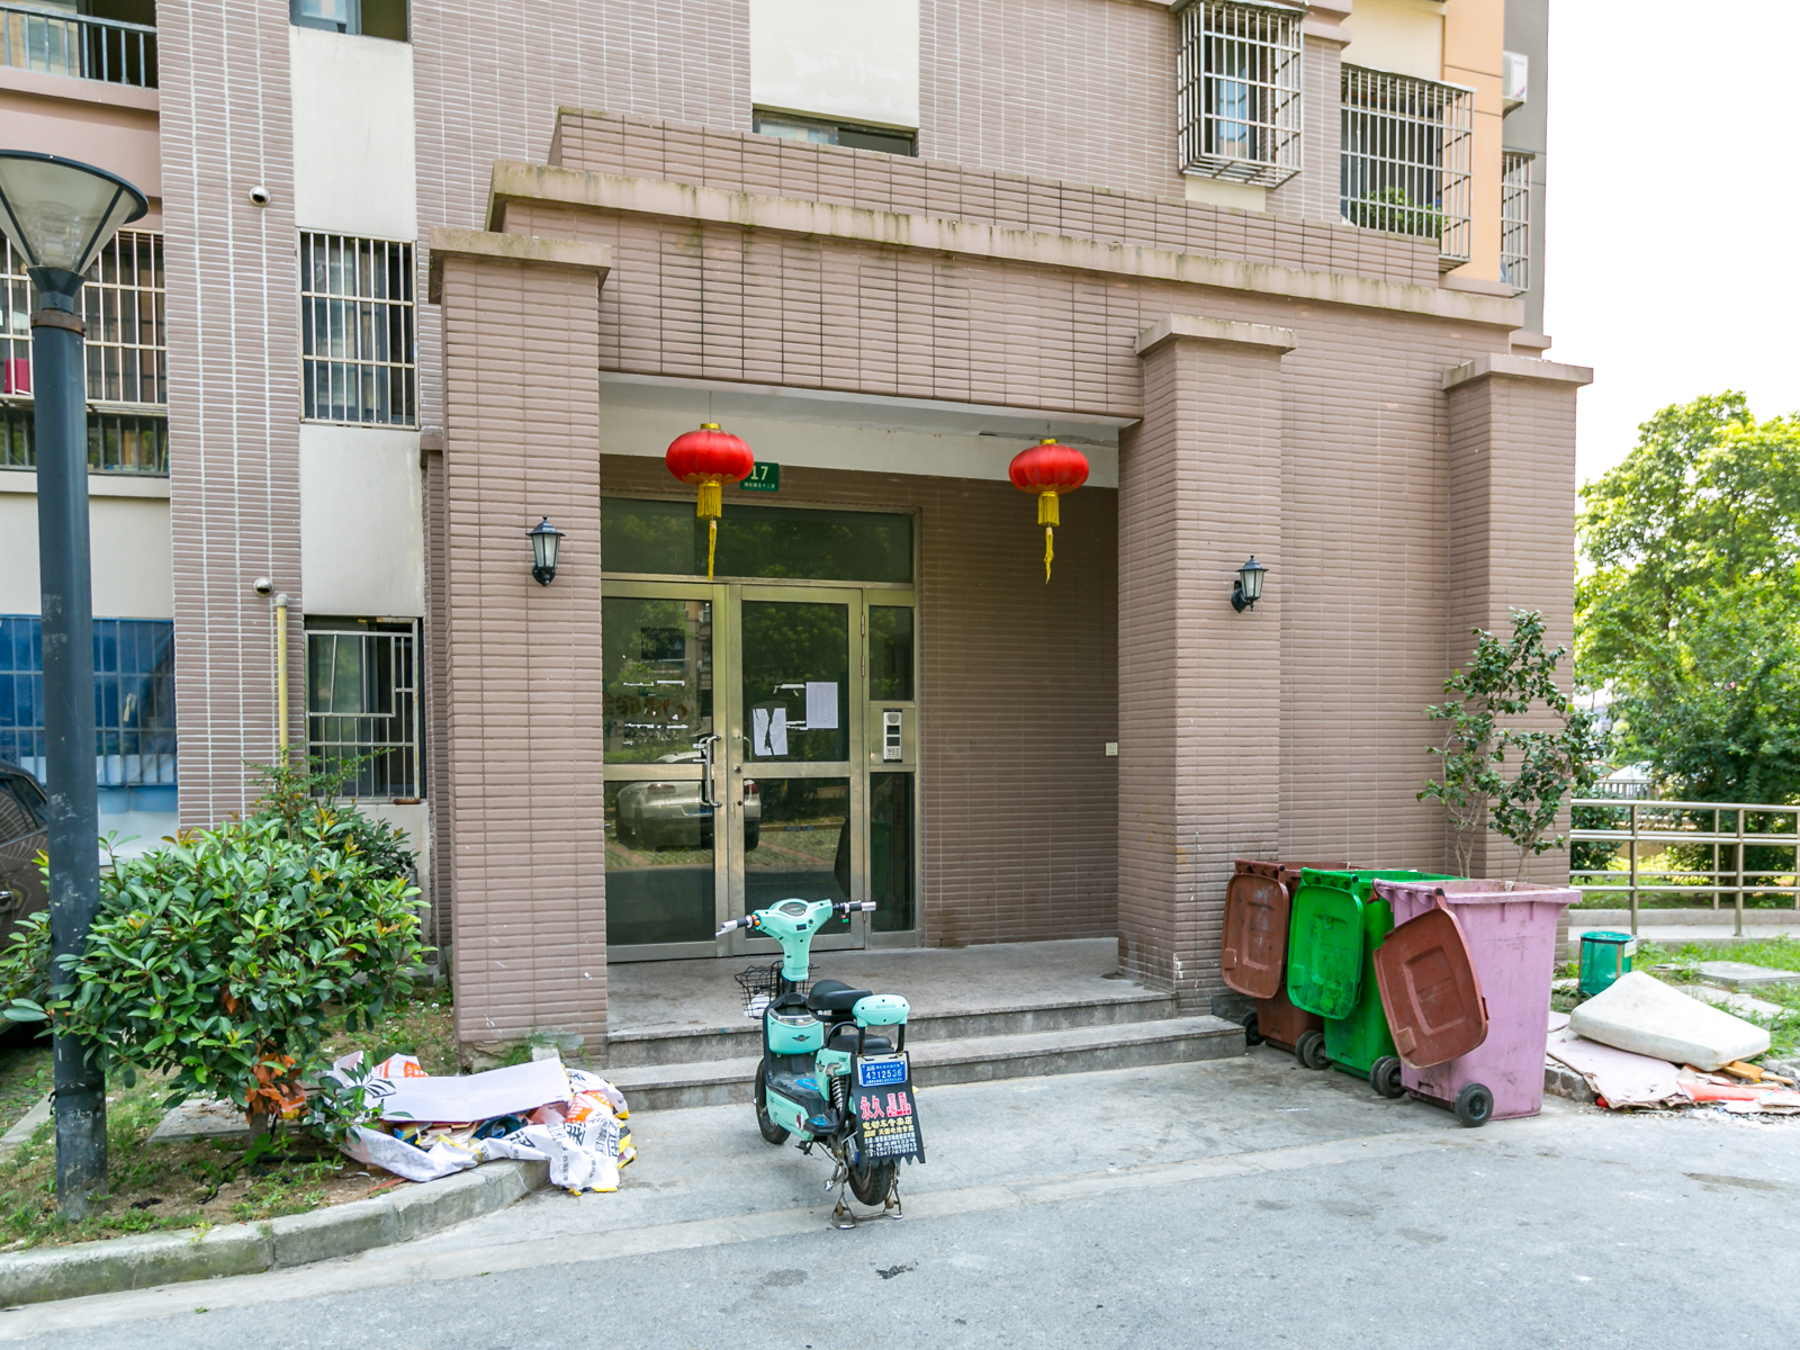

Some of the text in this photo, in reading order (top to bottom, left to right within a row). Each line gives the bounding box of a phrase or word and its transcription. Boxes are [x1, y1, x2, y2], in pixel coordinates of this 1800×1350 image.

[751, 465, 769, 480] 17
[865, 1068, 903, 1080] 4212536
[860, 1094, 885, 1120] 永久
